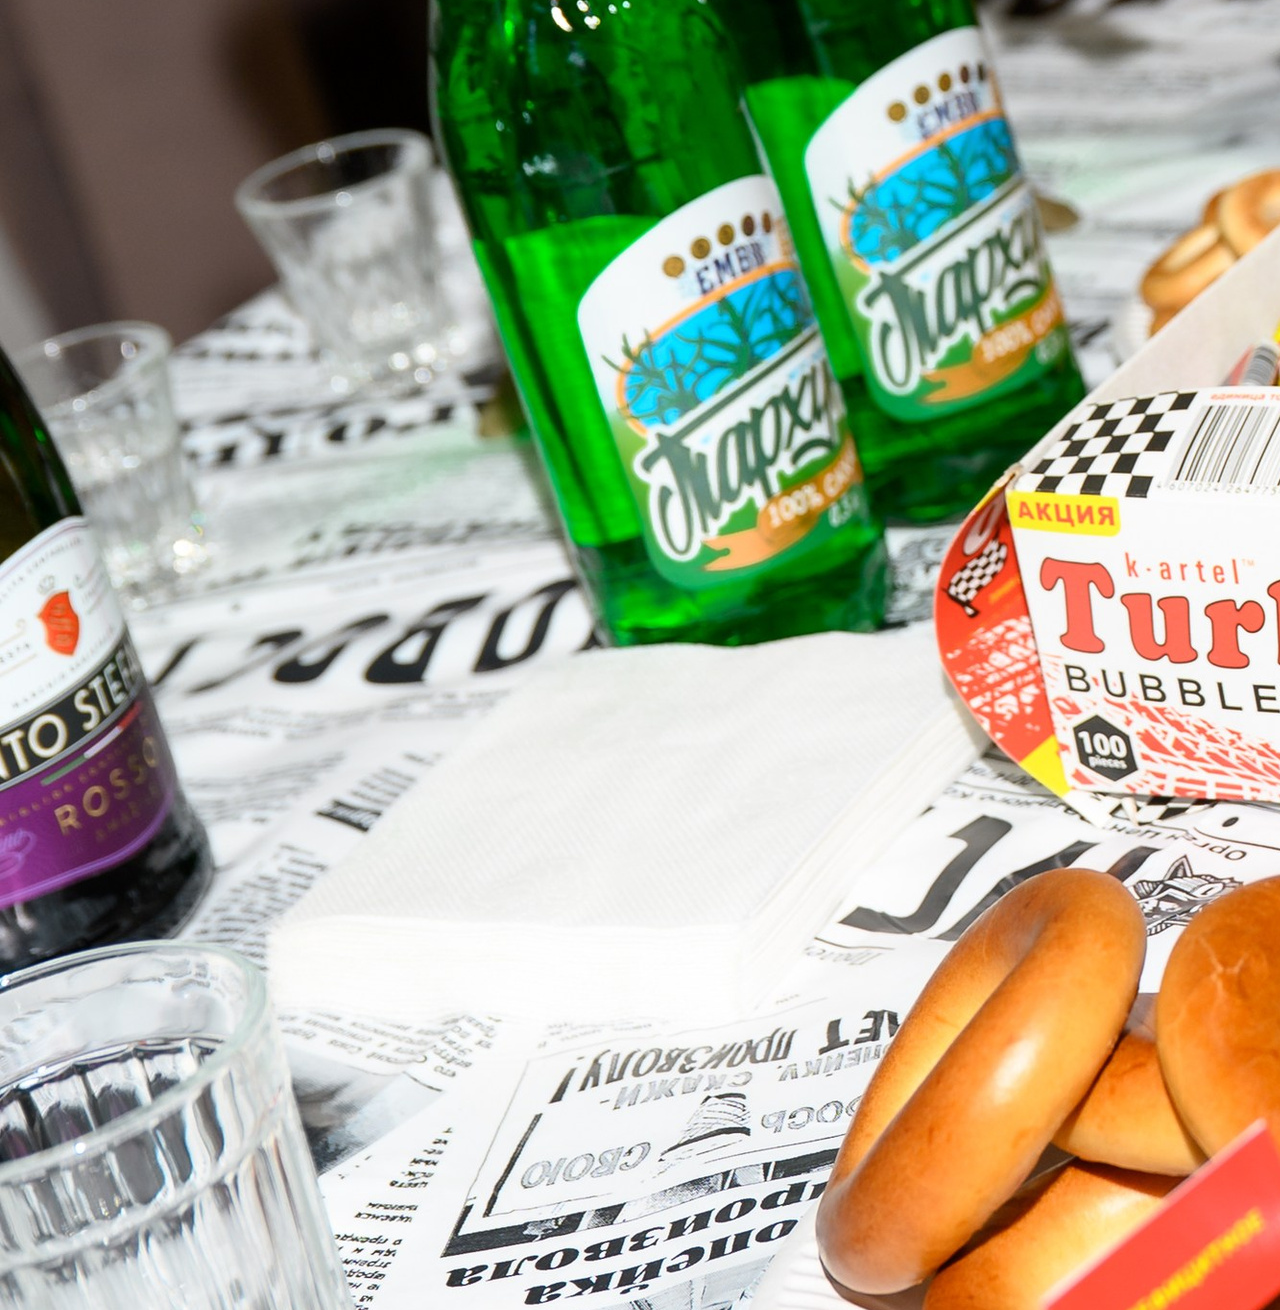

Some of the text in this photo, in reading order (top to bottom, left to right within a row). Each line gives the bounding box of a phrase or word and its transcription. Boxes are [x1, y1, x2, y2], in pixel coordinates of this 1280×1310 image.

[1017, 498, 1118, 529] АКЦИЯ
[0, 712, 68, 781] TO
[1077, 727, 1129, 763] 100
[1088, 751, 1130, 774] pieces
[54, 735, 161, 836] ROSSO
[548, 1029, 797, 1104] ПРОИЗВОЛУ!
[520, 1141, 652, 1190] СВОЮ
[524, 1219, 798, 1305] опейка
